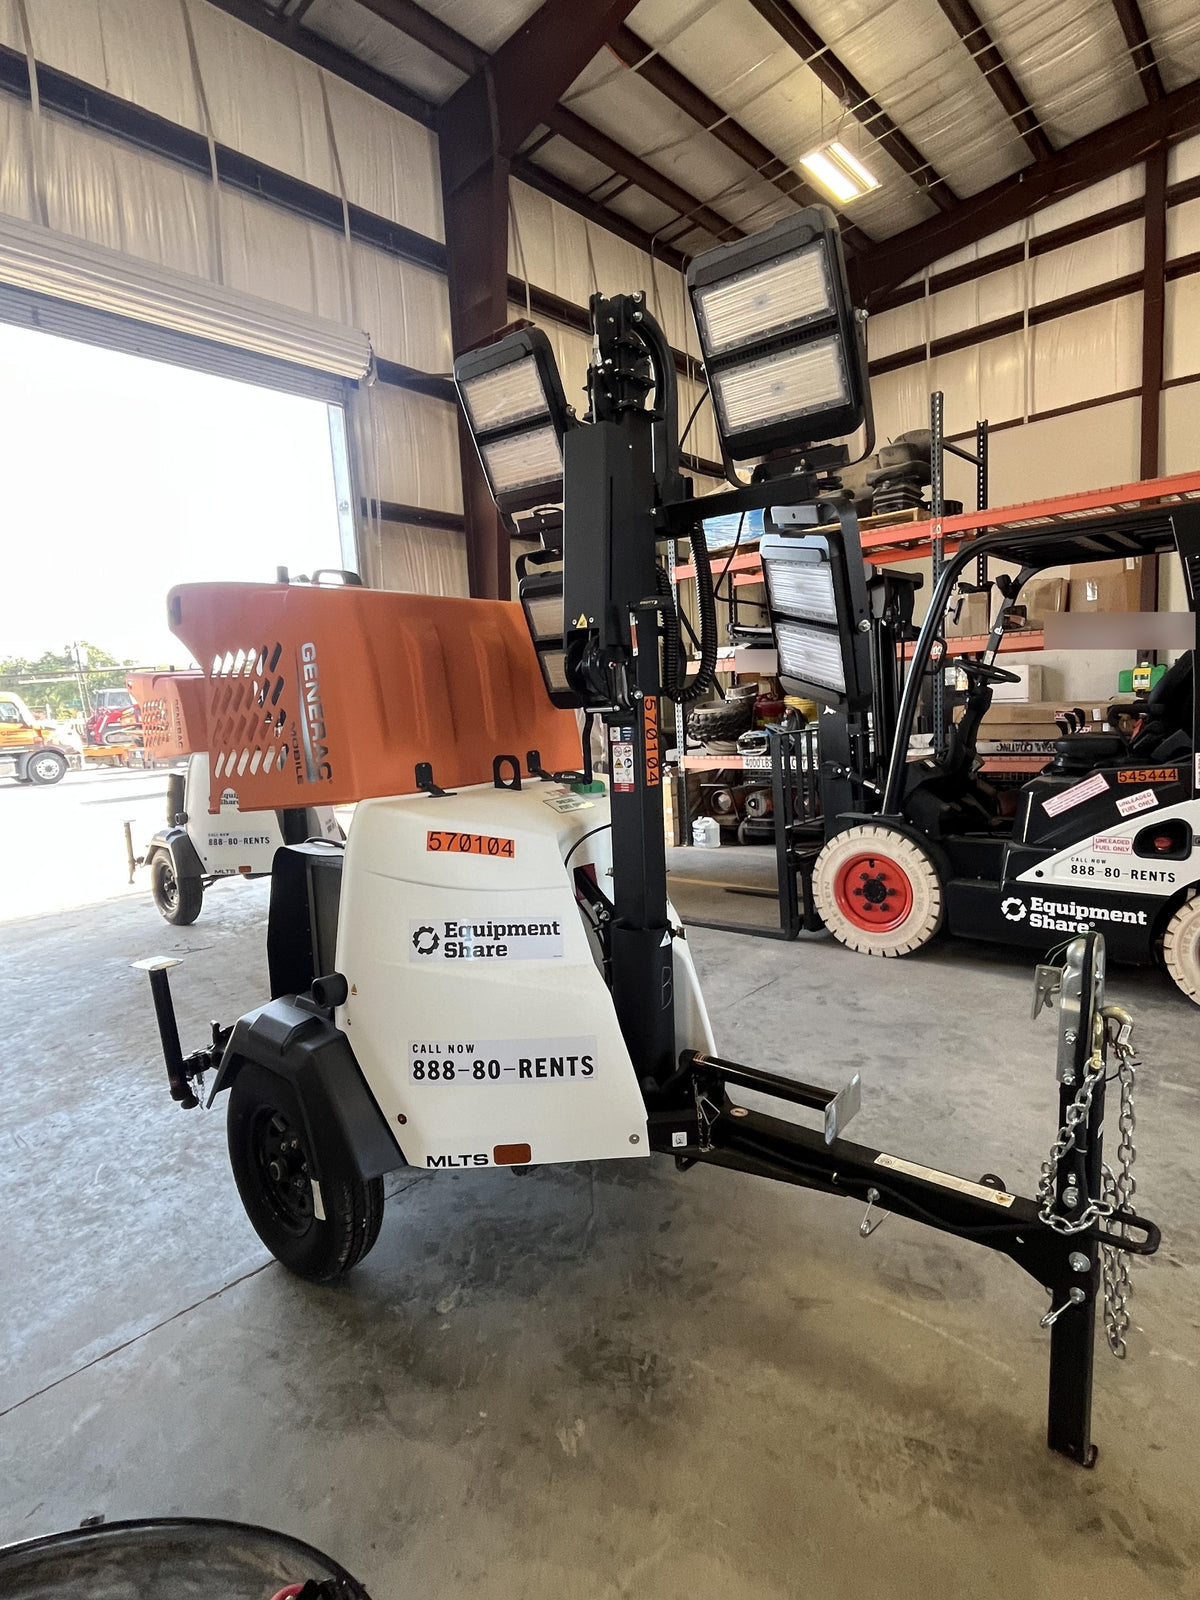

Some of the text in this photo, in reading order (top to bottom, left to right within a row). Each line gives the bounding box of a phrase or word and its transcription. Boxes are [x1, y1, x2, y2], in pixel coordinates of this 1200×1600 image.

[300, 642, 333, 781] GENERAC
[644, 698, 659, 784] 570104
[290, 721, 304, 785] MOBILE
[1119, 769, 1178, 783] 545444
[1118, 792, 1152, 807] UNLEADED
[1121, 798, 1155, 814] FUEL ONLY
[428, 831, 514, 857] 570104
[1095, 838, 1130, 846] UNLEADED
[1071, 865, 1176, 883] 888-80-RENTS
[1030, 897, 1147, 925] Equipment
[444, 921, 561, 941] Equipment
[1029, 913, 1089, 934] Share
[444, 942, 508, 958] Share
[412, 1043, 475, 1054] CALL NOW
[412, 1055, 594, 1080] 888-80-RENTS
[426, 1153, 489, 1167] MLTS
